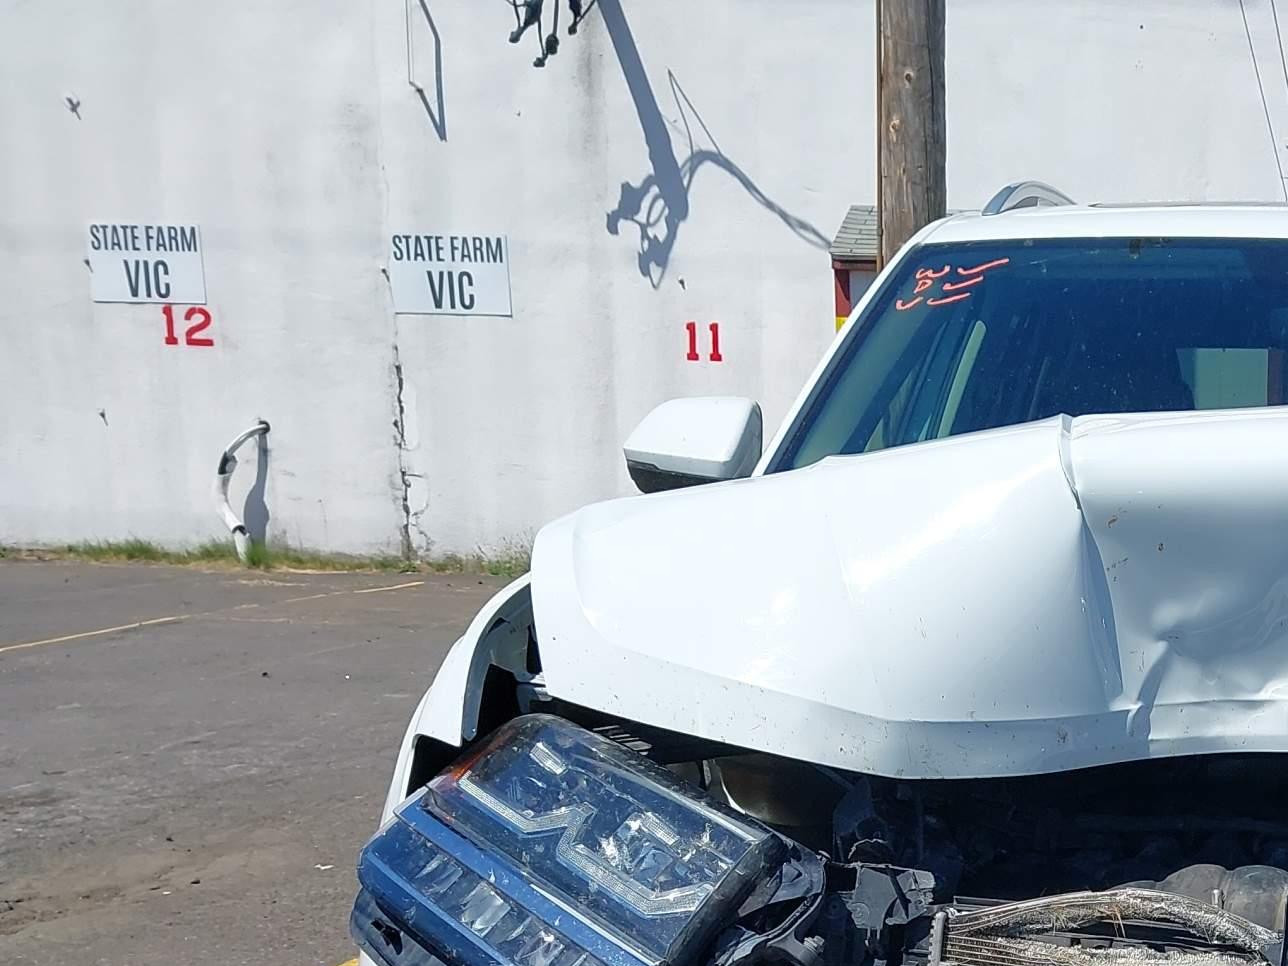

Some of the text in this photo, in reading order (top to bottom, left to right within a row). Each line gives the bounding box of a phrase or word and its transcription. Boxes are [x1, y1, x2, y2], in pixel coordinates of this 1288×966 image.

[90, 225, 198, 252] STATE FARM
[392, 234, 504, 263] STATE FARM
[123, 259, 171, 299] VIC
[426, 270, 475, 310] VIC
[162, 304, 214, 348] 12
[686, 321, 722, 363] 11
